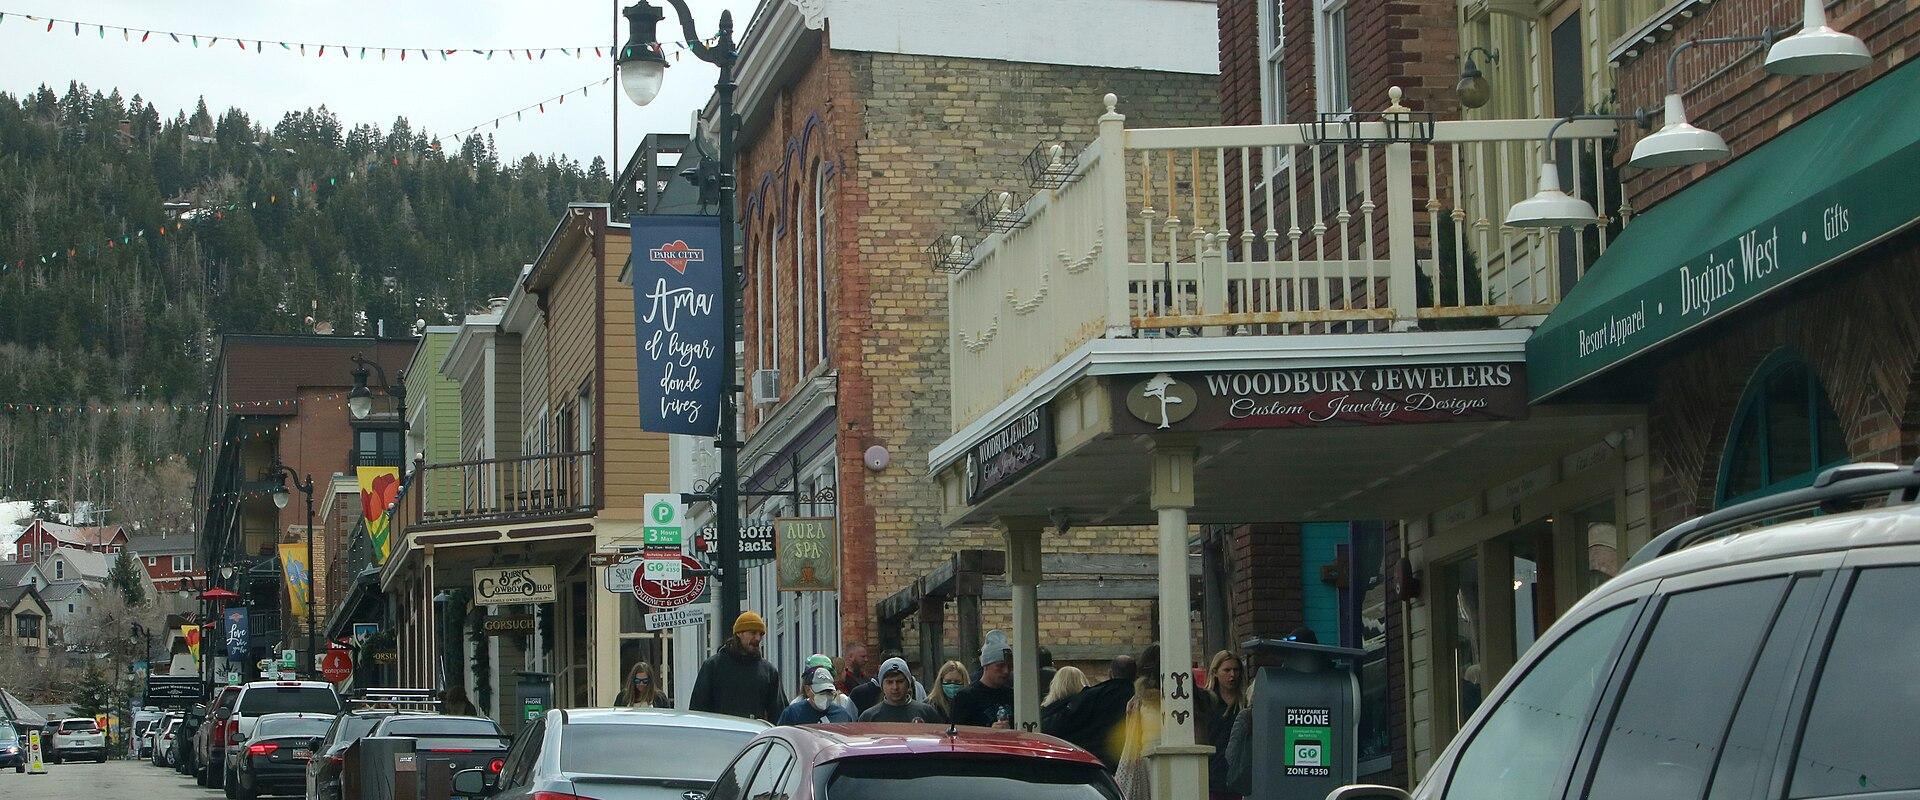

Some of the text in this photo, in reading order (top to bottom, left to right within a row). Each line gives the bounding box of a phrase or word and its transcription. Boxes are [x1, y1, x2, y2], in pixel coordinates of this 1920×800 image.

[654, 251, 700, 259] PARK CITY
[1579, 203, 1849, 357] Resort Apparel Dugins West Gifts
[643, 278, 714, 332] Ama
[645, 330, 715, 367] el lugar
[660, 362, 702, 395] donde
[1204, 364, 1512, 397] WOODBURY JEWELERS
[660, 397, 703, 423] vives
[1229, 392, 1489, 421] Custom Jewelry Designs
[979, 409, 1039, 464] WOODBURY JEWELERS
[659, 507, 669, 520] P
[649, 530, 658, 542] 3
[787, 522, 826, 540] AURA
[795, 541, 820, 559] SPA
[478, 570, 552, 598] COWBOY SHOP
[635, 585, 666, 606] GOURMET
[673, 597, 689, 606] GIFT
[691, 580, 704, 598] SHOP
[485, 619, 535, 630] GORSUCH
[652, 611, 686, 622] GELATO
[652, 619, 687, 628] ESPRESSO
[1287, 714, 1329, 725] PHONE
